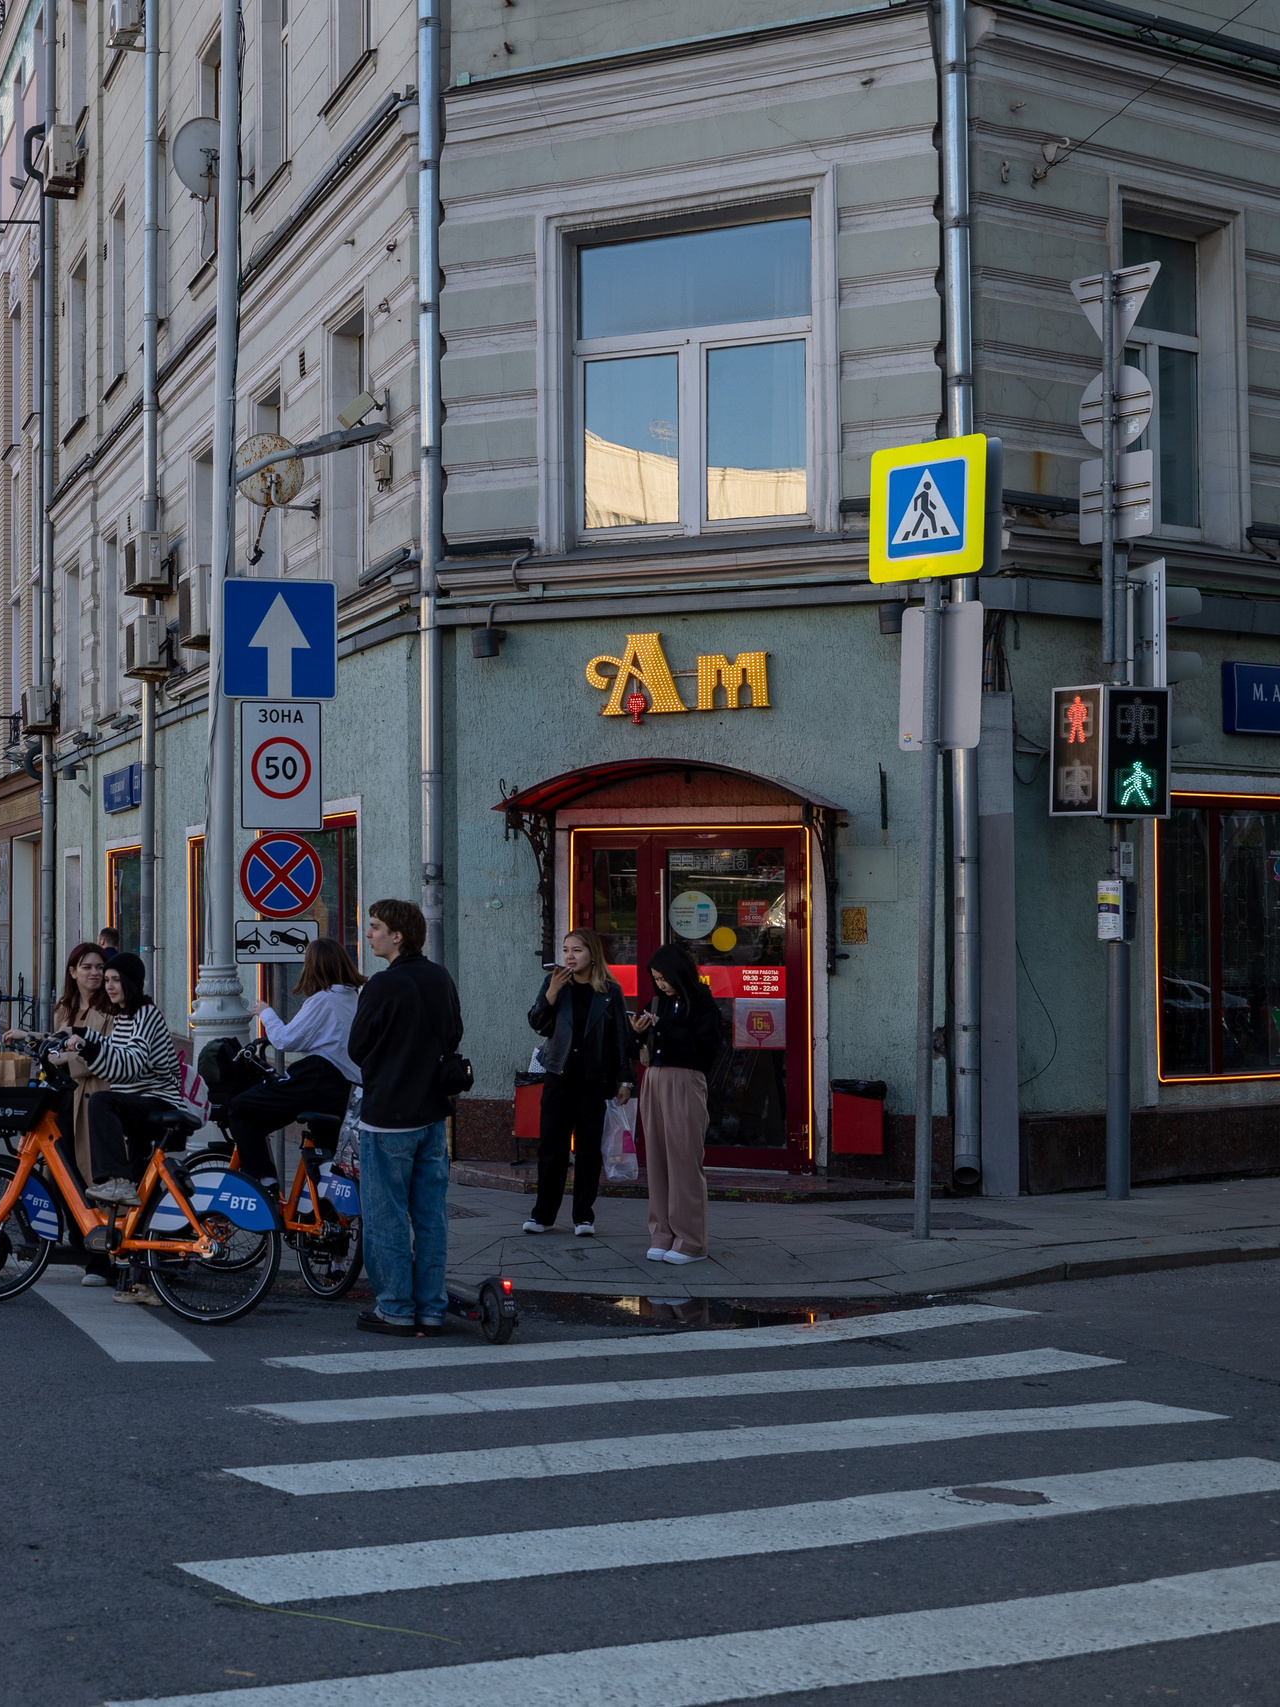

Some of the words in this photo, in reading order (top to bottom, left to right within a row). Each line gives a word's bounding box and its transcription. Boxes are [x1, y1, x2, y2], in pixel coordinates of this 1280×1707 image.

[1253, 683, 1268, 702] М.
[258, 709, 304, 724] ЗОНА
[265, 756, 298, 780] 50
[335, 1183, 352, 1198] ВТБ
[32, 1197, 50, 1209] ВТБ
[230, 1196, 257, 1211] ВТБ
